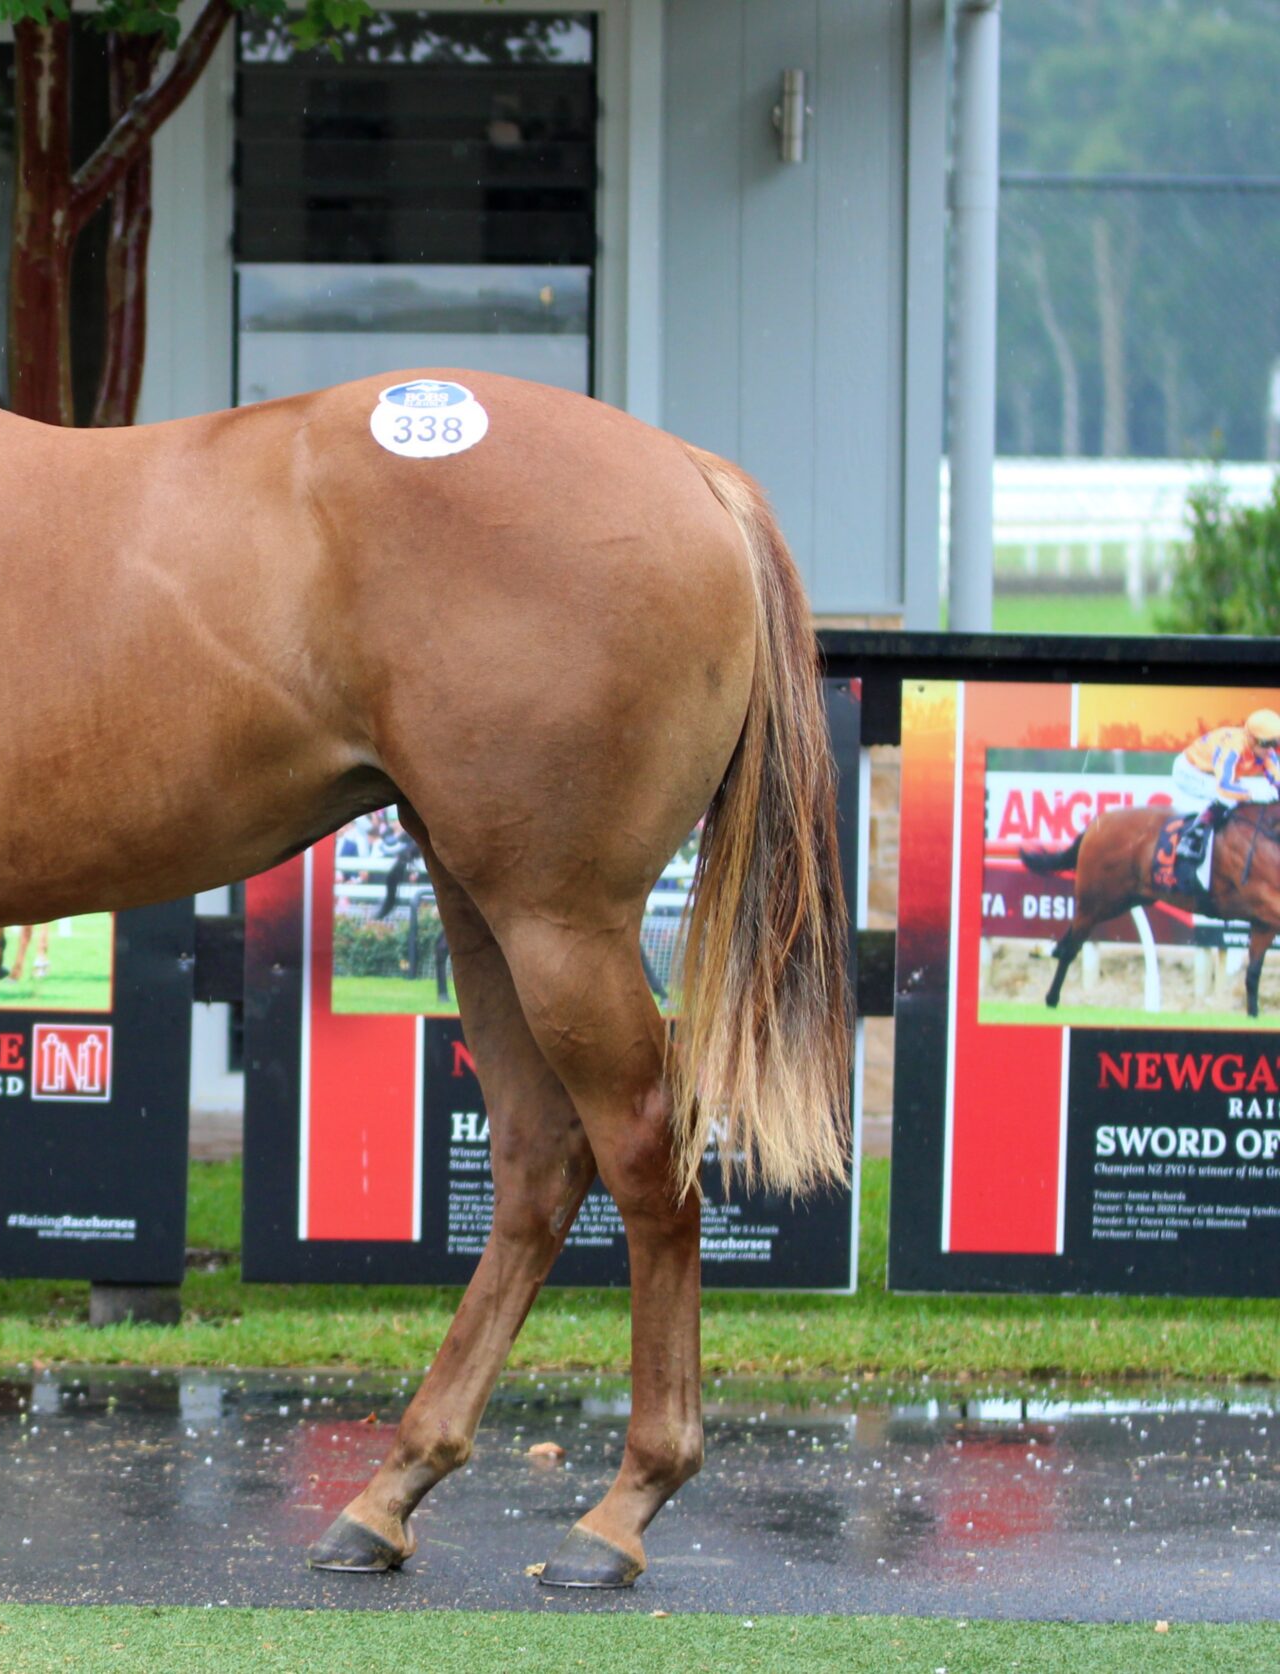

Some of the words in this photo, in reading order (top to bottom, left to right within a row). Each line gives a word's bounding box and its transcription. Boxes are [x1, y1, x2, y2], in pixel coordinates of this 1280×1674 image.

[393, 415, 463, 444] 338
[1023, 895, 1075, 921] DESI
[1098, 1051, 1280, 1093] NEWGA
[1228, 1097, 1280, 1120] RAI
[1095, 1125, 1227, 1158] SWORD
[1235, 1128, 1280, 1160] OF
[449, 1147, 487, 1159] Winner
[449, 1159, 481, 1171] Stakes
[1094, 1163, 1145, 1178] Champion
[1148, 1163, 1163, 1176] NZ
[1165, 1164, 1186, 1177] 2YO
[1199, 1165, 1234, 1177] winner
[1236, 1164, 1247, 1180] of
[1248, 1166, 1264, 1178] the
[1094, 1190, 1126, 1201] Trainer:
[1152, 1191, 1187, 1202] Richards
[1252, 1206, 1280, 1218] Syndic
[7, 1215, 137, 1231] #RaisingRacehorses
[700, 1236, 772, 1251] Racehorses
[700, 1251, 772, 1263] newgate.com.au
